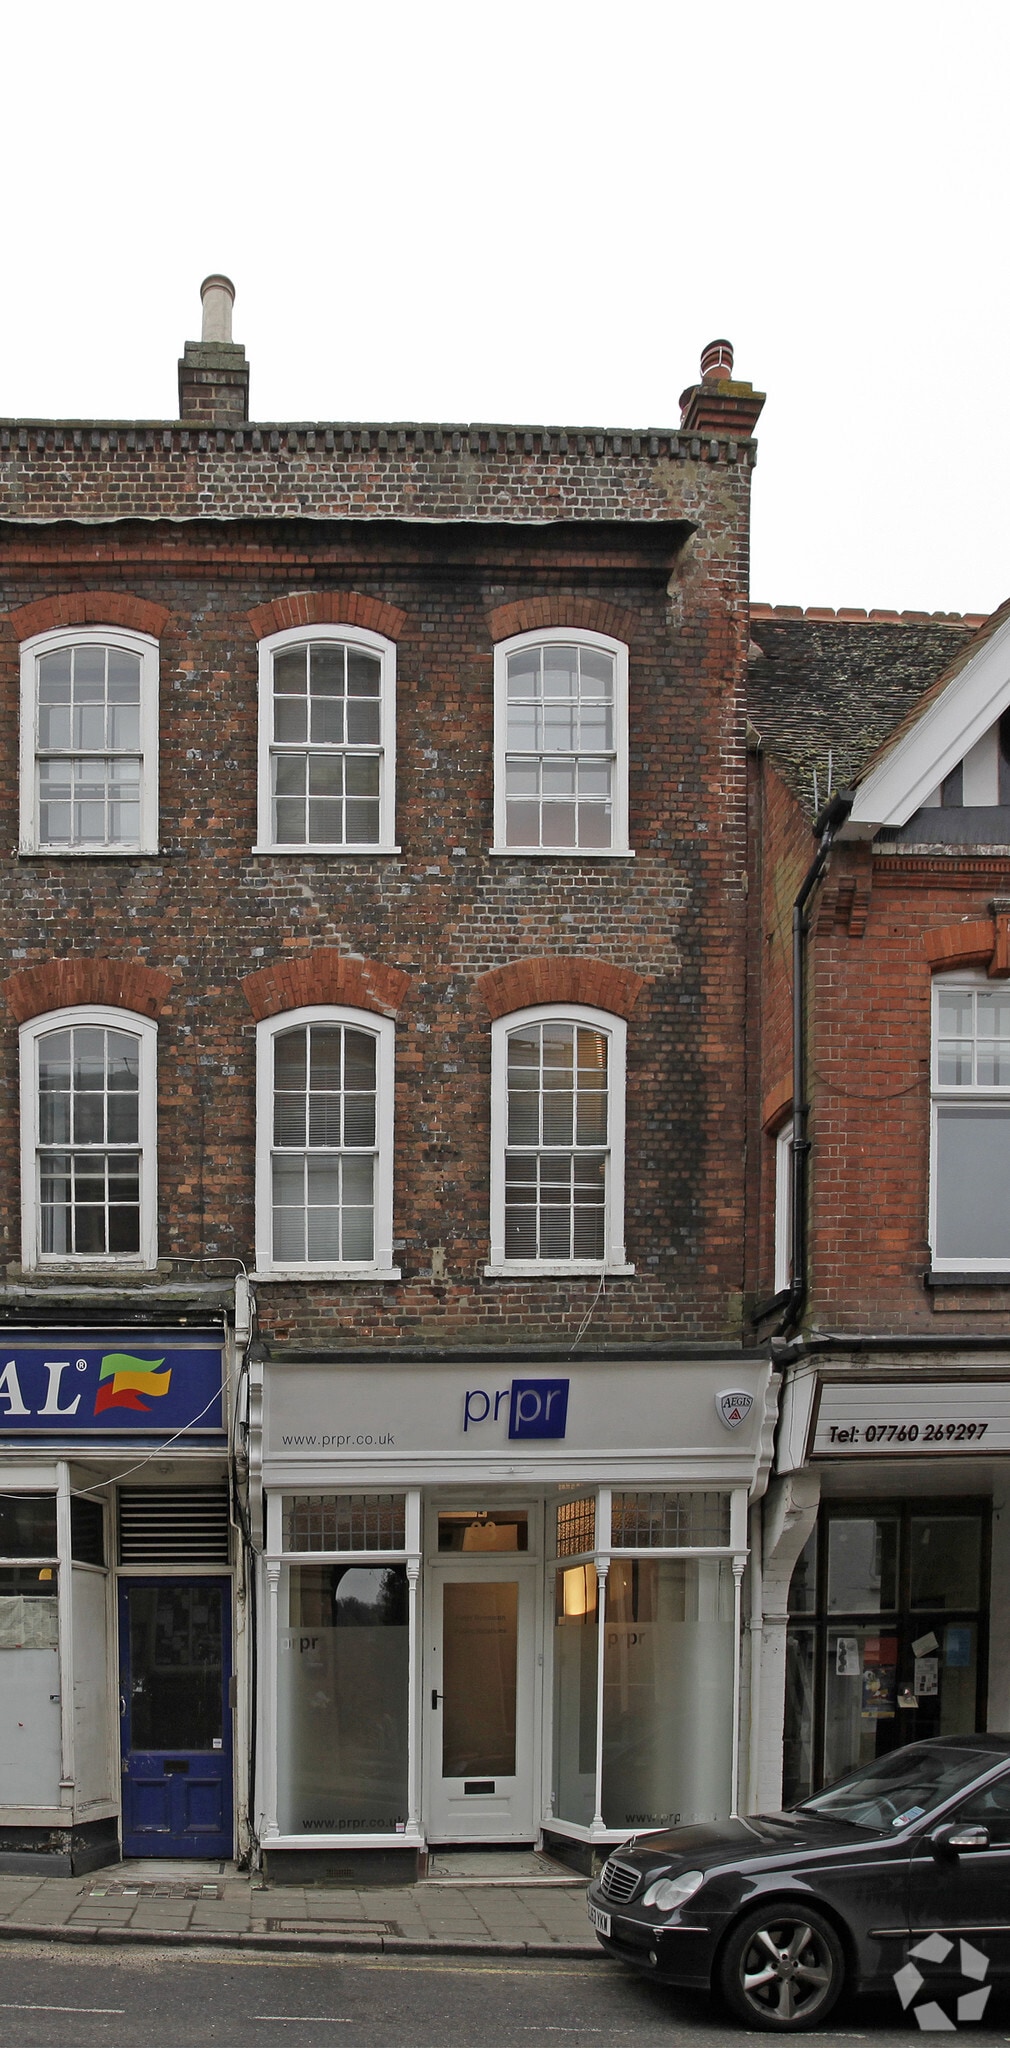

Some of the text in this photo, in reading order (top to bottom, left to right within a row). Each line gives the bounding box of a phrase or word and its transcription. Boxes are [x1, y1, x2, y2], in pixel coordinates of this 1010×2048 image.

[463, 1389, 561, 1432] prpr
[723, 1397, 751, 1408] AEGIS
[282, 1432, 395, 1447] www.prpr.co.uk
[829, 1423, 989, 1443] Tel: 07760 269297
